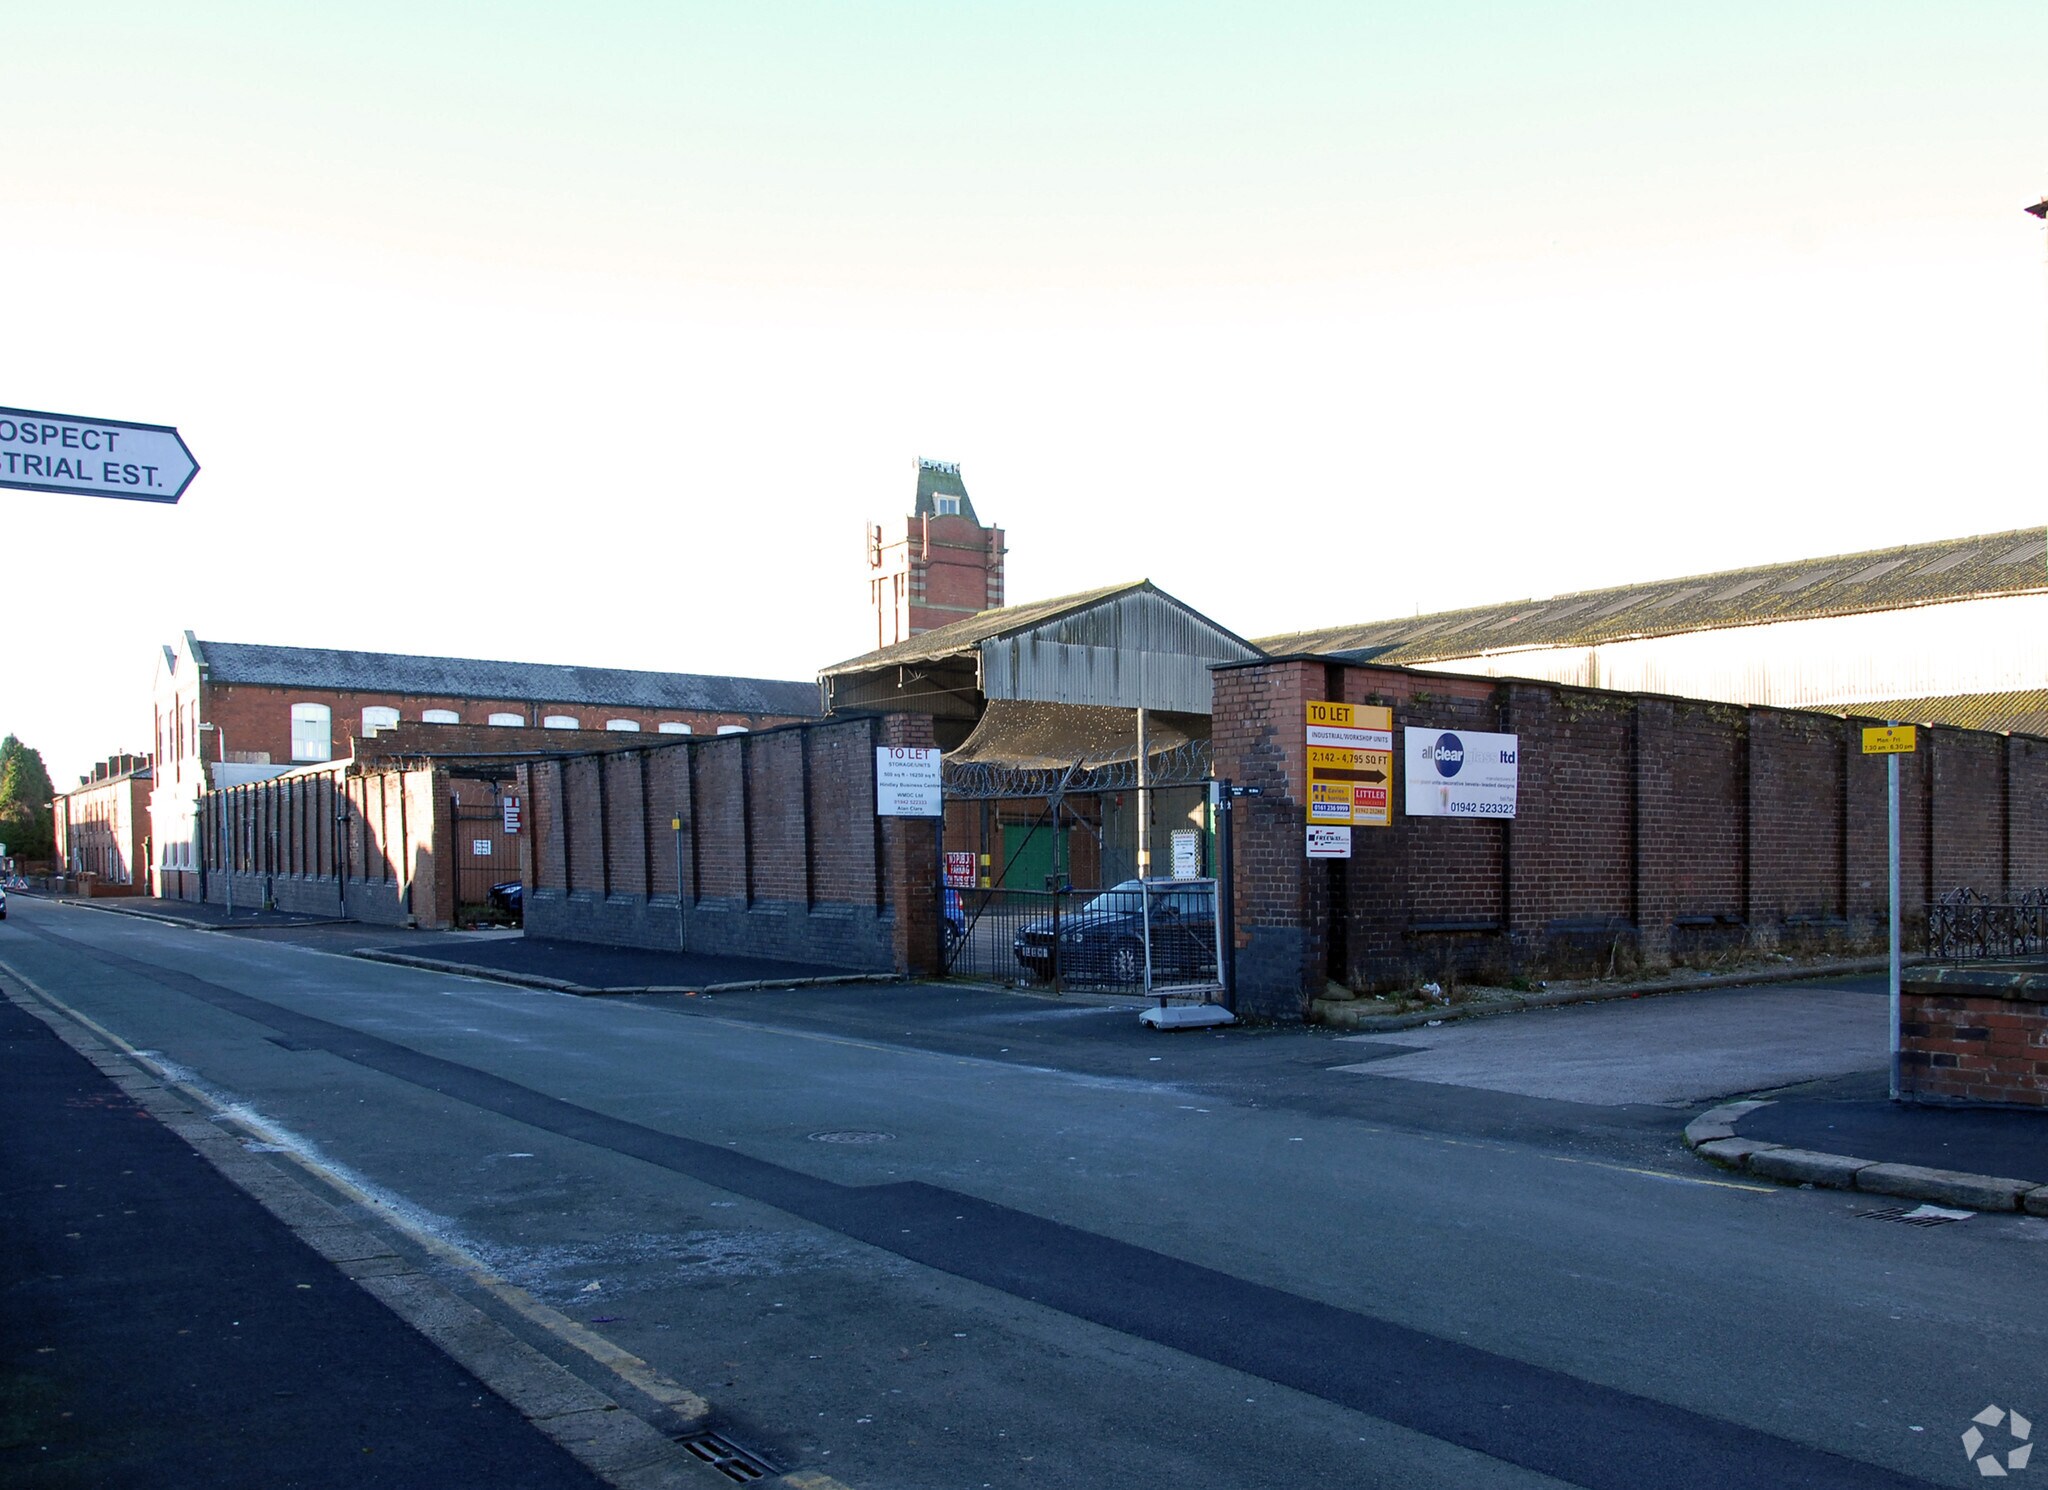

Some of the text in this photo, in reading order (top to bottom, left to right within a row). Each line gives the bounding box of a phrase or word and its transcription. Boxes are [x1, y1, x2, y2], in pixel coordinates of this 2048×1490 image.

[0, 451, 162, 487] TRIAL EST.
[1311, 705, 1350, 722] TO LET
[1312, 731, 1389, 744] INDUSTRIAL/WORKSHOP UNITS
[888, 747, 930, 760] TO LET
[1312, 752, 1335, 763] 2,142
[1342, 754, 1364, 764] 4,795
[1365, 755, 1376, 765] SQ
[1378, 756, 1388, 765] FT
[1422, 746, 1433, 760] all
[1435, 746, 1463, 761] clear
[1500, 750, 1516, 764] ltd
[1355, 789, 1385, 799] LITTLER
[1450, 802, 1515, 814] 01942 523322
